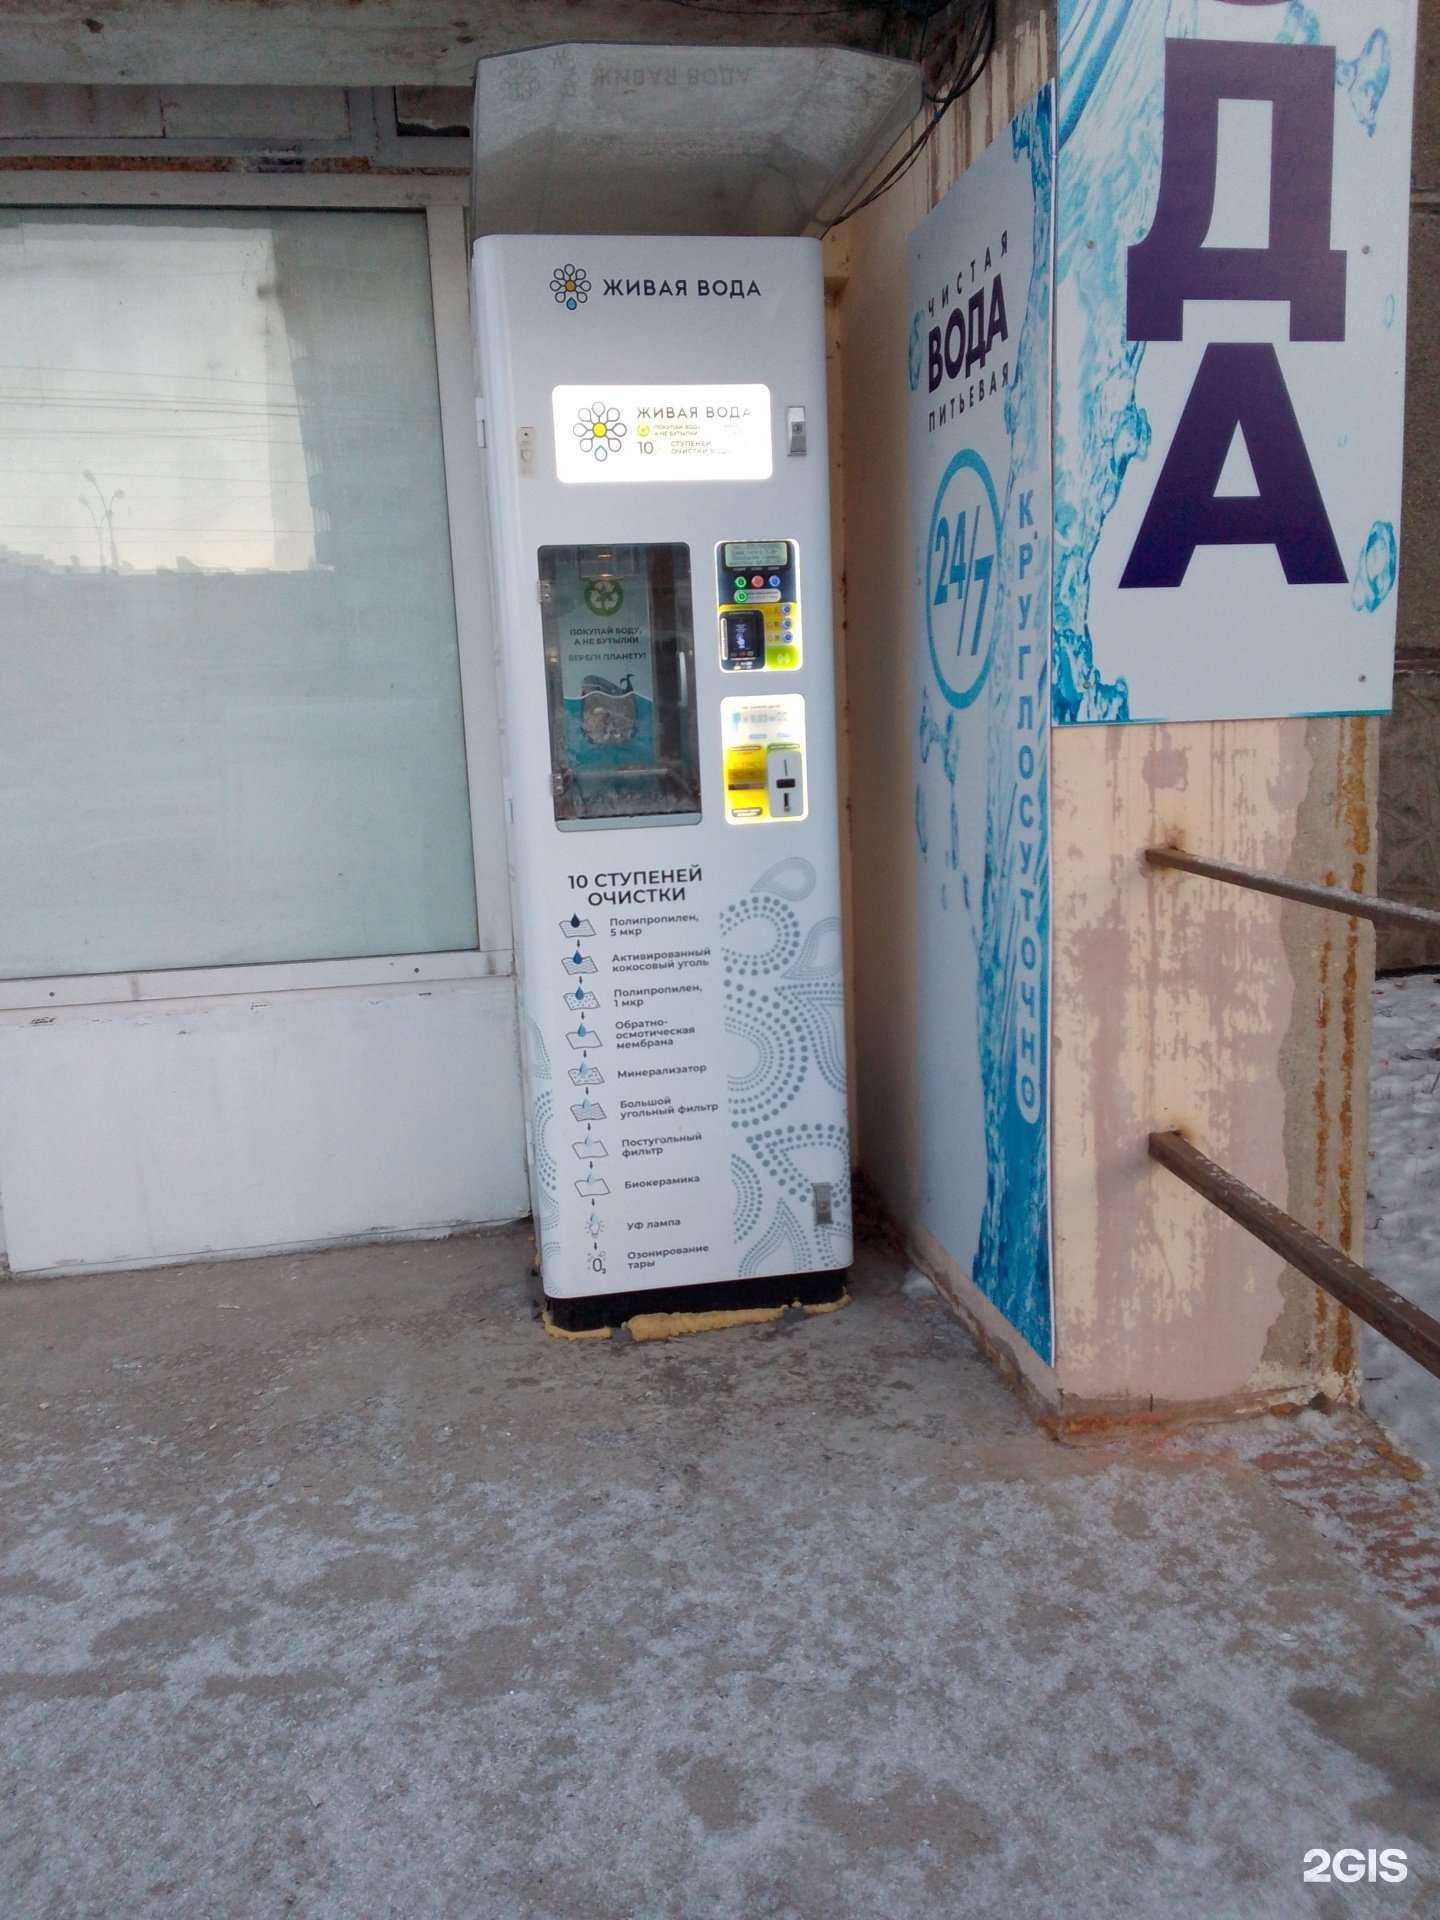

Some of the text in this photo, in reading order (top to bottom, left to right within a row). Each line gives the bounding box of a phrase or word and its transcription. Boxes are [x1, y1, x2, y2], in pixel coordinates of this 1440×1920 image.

[928, 230, 1009, 317] ЧИСТАЯ
[602, 279, 761, 298] ЖИВАЯ ВОДА
[1118, 0, 1348, 588] ДА
[928, 273, 1008, 394] ВОДА
[928, 361, 1009, 433] ПИТЬЕВАЯ
[636, 406, 698, 419] ЖИВАЯ
[637, 441, 654, 455] 10
[934, 505, 994, 657] 24/7
[574, 638, 581, 646] А
[596, 636, 640, 645] БУТЫЛКИ
[1017, 490, 1037, 1110] КРУГЛОСУТОЧНО
[568, 864, 703, 890] 10 СТУПЕНЕЙ
[587, 887, 686, 906] ОЧИСТКИ
[609, 914, 700, 927] Полипропилен,
[610, 928, 642, 937] 5 мкр
[612, 948, 711, 962] Активированный
[612, 959, 710, 973] кокосовый уголь
[613, 985, 703, 998] Полипропилен,
[621, 999, 644, 1008] мкр
[615, 1019, 668, 1031] Обратно-
[615, 1027, 696, 1040] осмотическая
[616, 1037, 674, 1050] мембрана
[617, 1064, 707, 1079] Минерализатор
[619, 1096, 672, 1109] Большой
[619, 1103, 719, 1121] угольный фильтр
[621, 1132, 702, 1148] Постугольный
[622, 1147, 664, 1159] фильтр
[624, 1175, 701, 1190] Биокерамика
[627, 1218, 681, 1231] УФ лампа
[627, 1244, 710, 1261] Озонирование
[627, 1260, 656, 1271] тары
